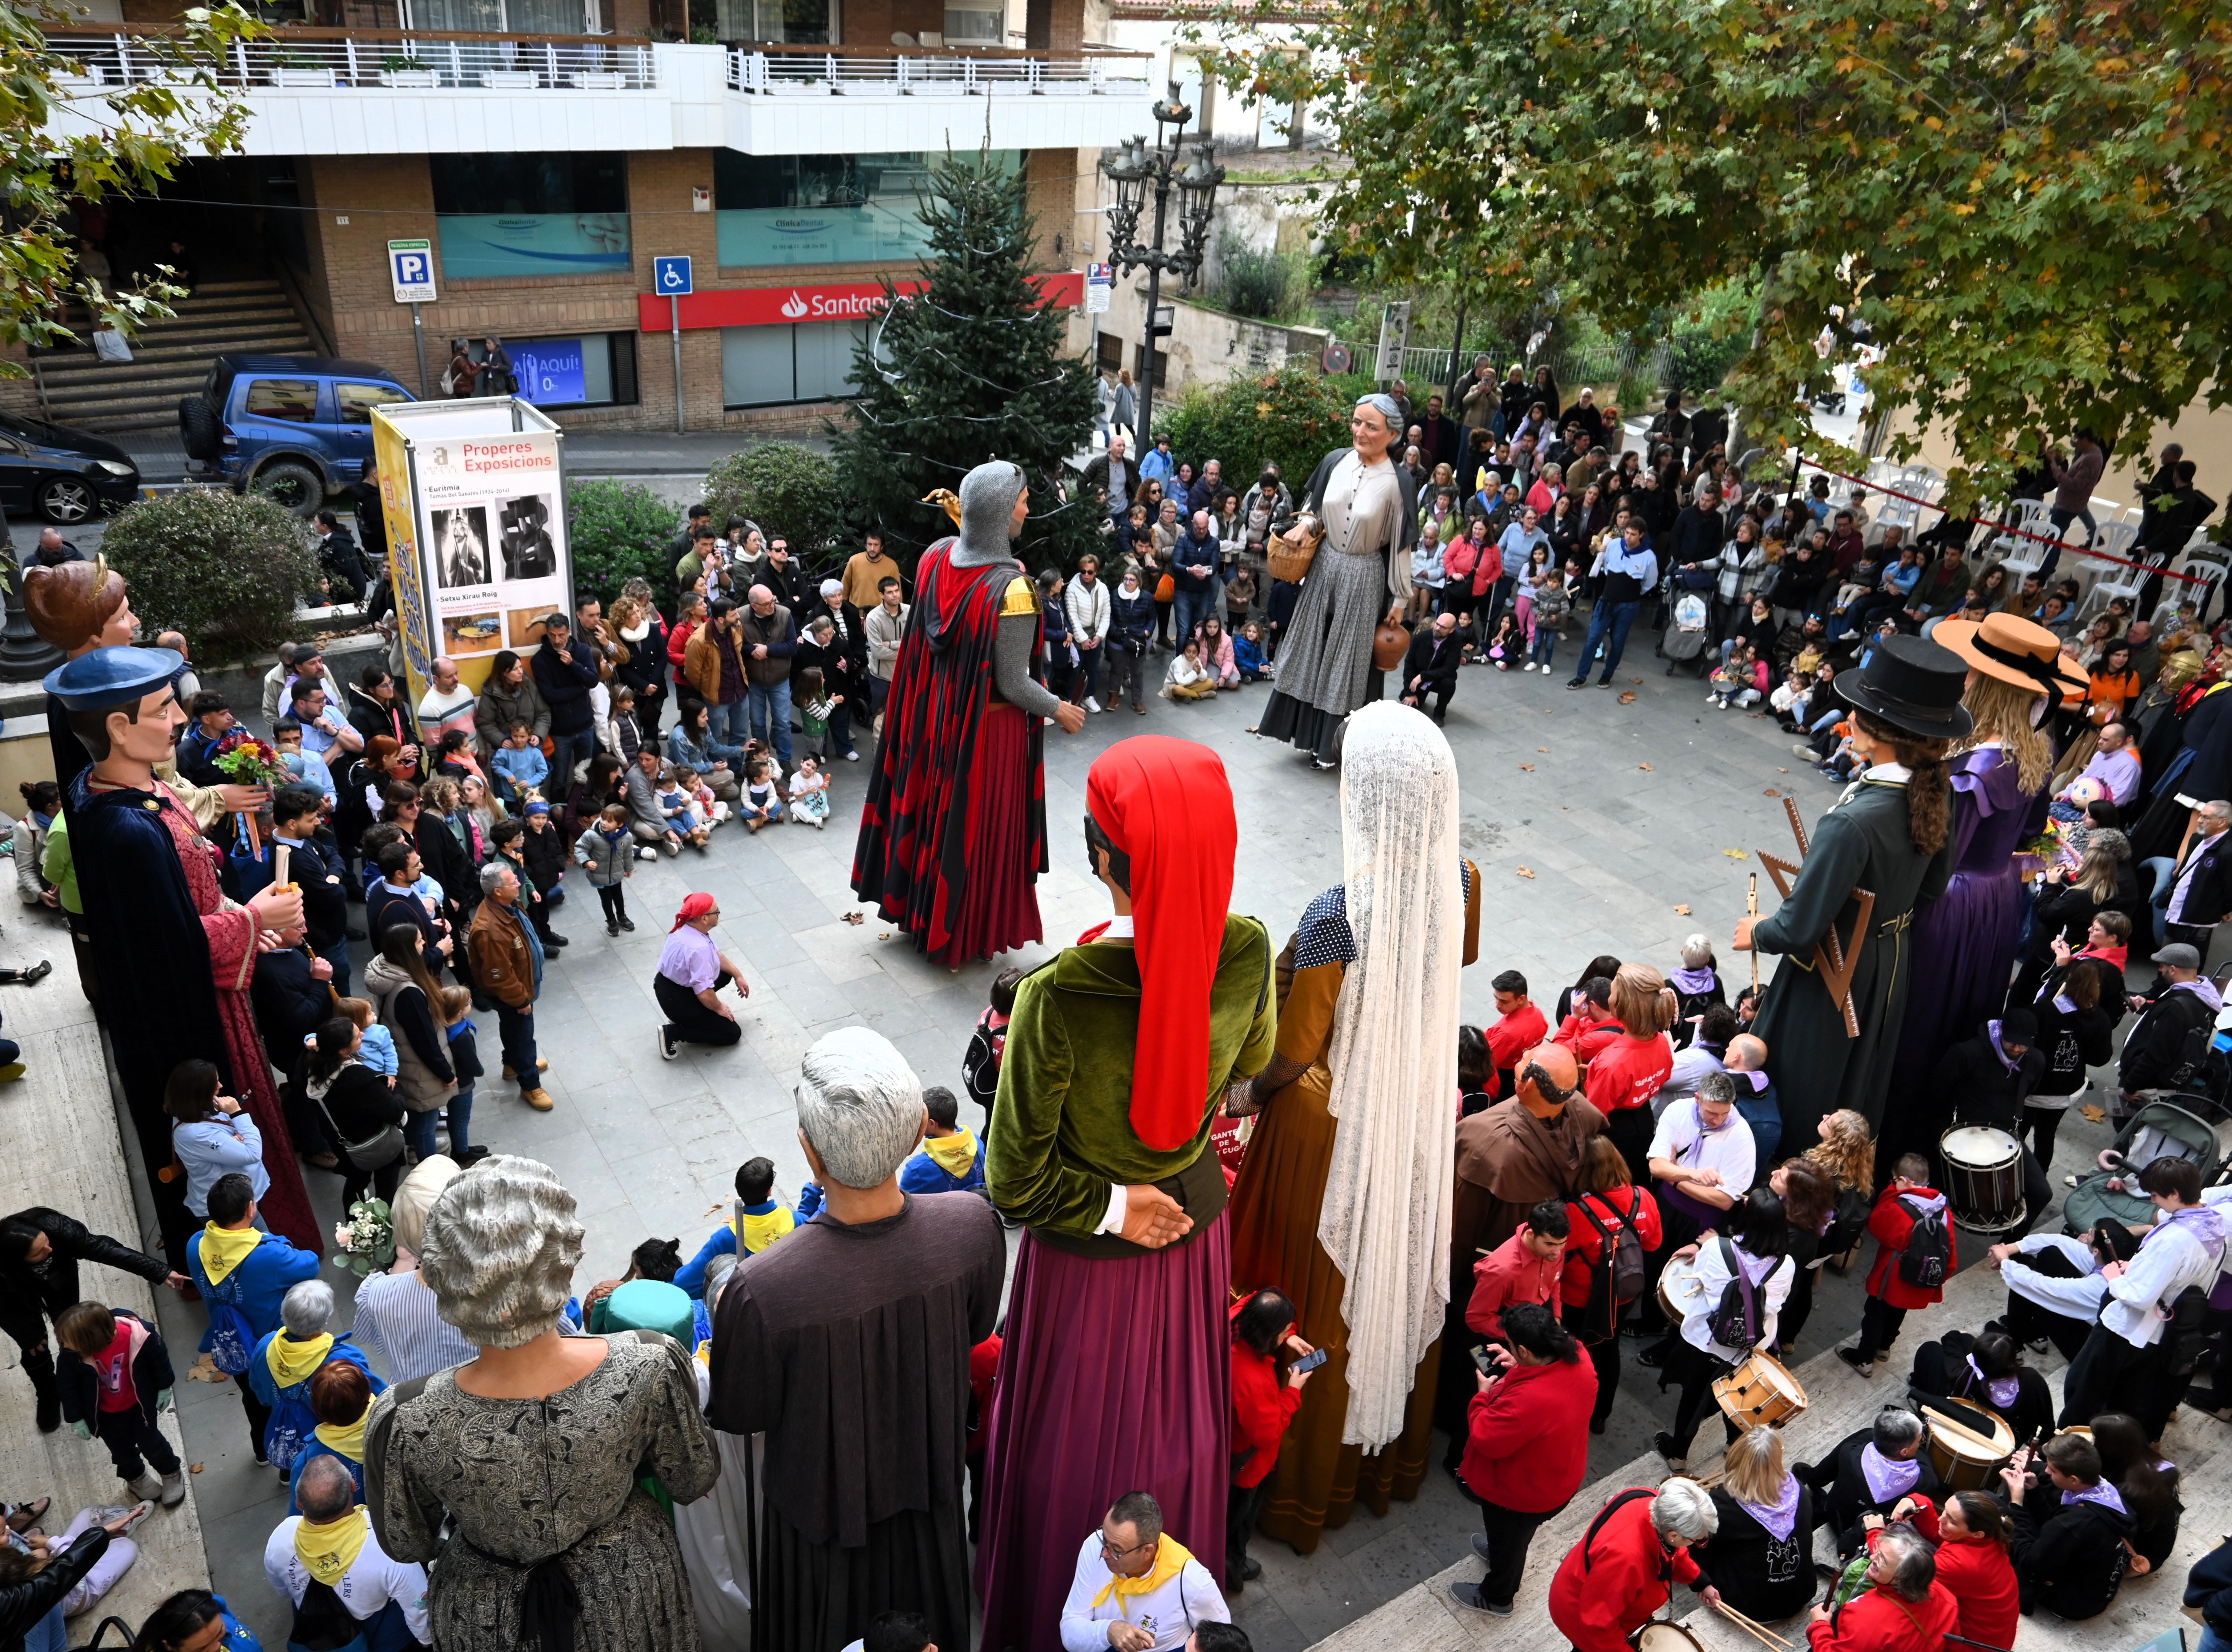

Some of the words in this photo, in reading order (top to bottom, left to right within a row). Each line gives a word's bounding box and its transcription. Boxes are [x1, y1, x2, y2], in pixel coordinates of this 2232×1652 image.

[401, 256, 422, 282] P
[1091, 263, 1099, 276] P
[812, 293, 913, 315] Santan
[539, 354, 579, 372] AQUÍ!
[463, 442, 532, 458] Properes
[465, 456, 552, 473] Exposicions
[1210, 1129, 1237, 1141] GANTE
[1219, 1139, 1229, 1147] DE
[1744, 1504, 1773, 1524] ARETS
[342, 1571, 352, 1598] LLERS
